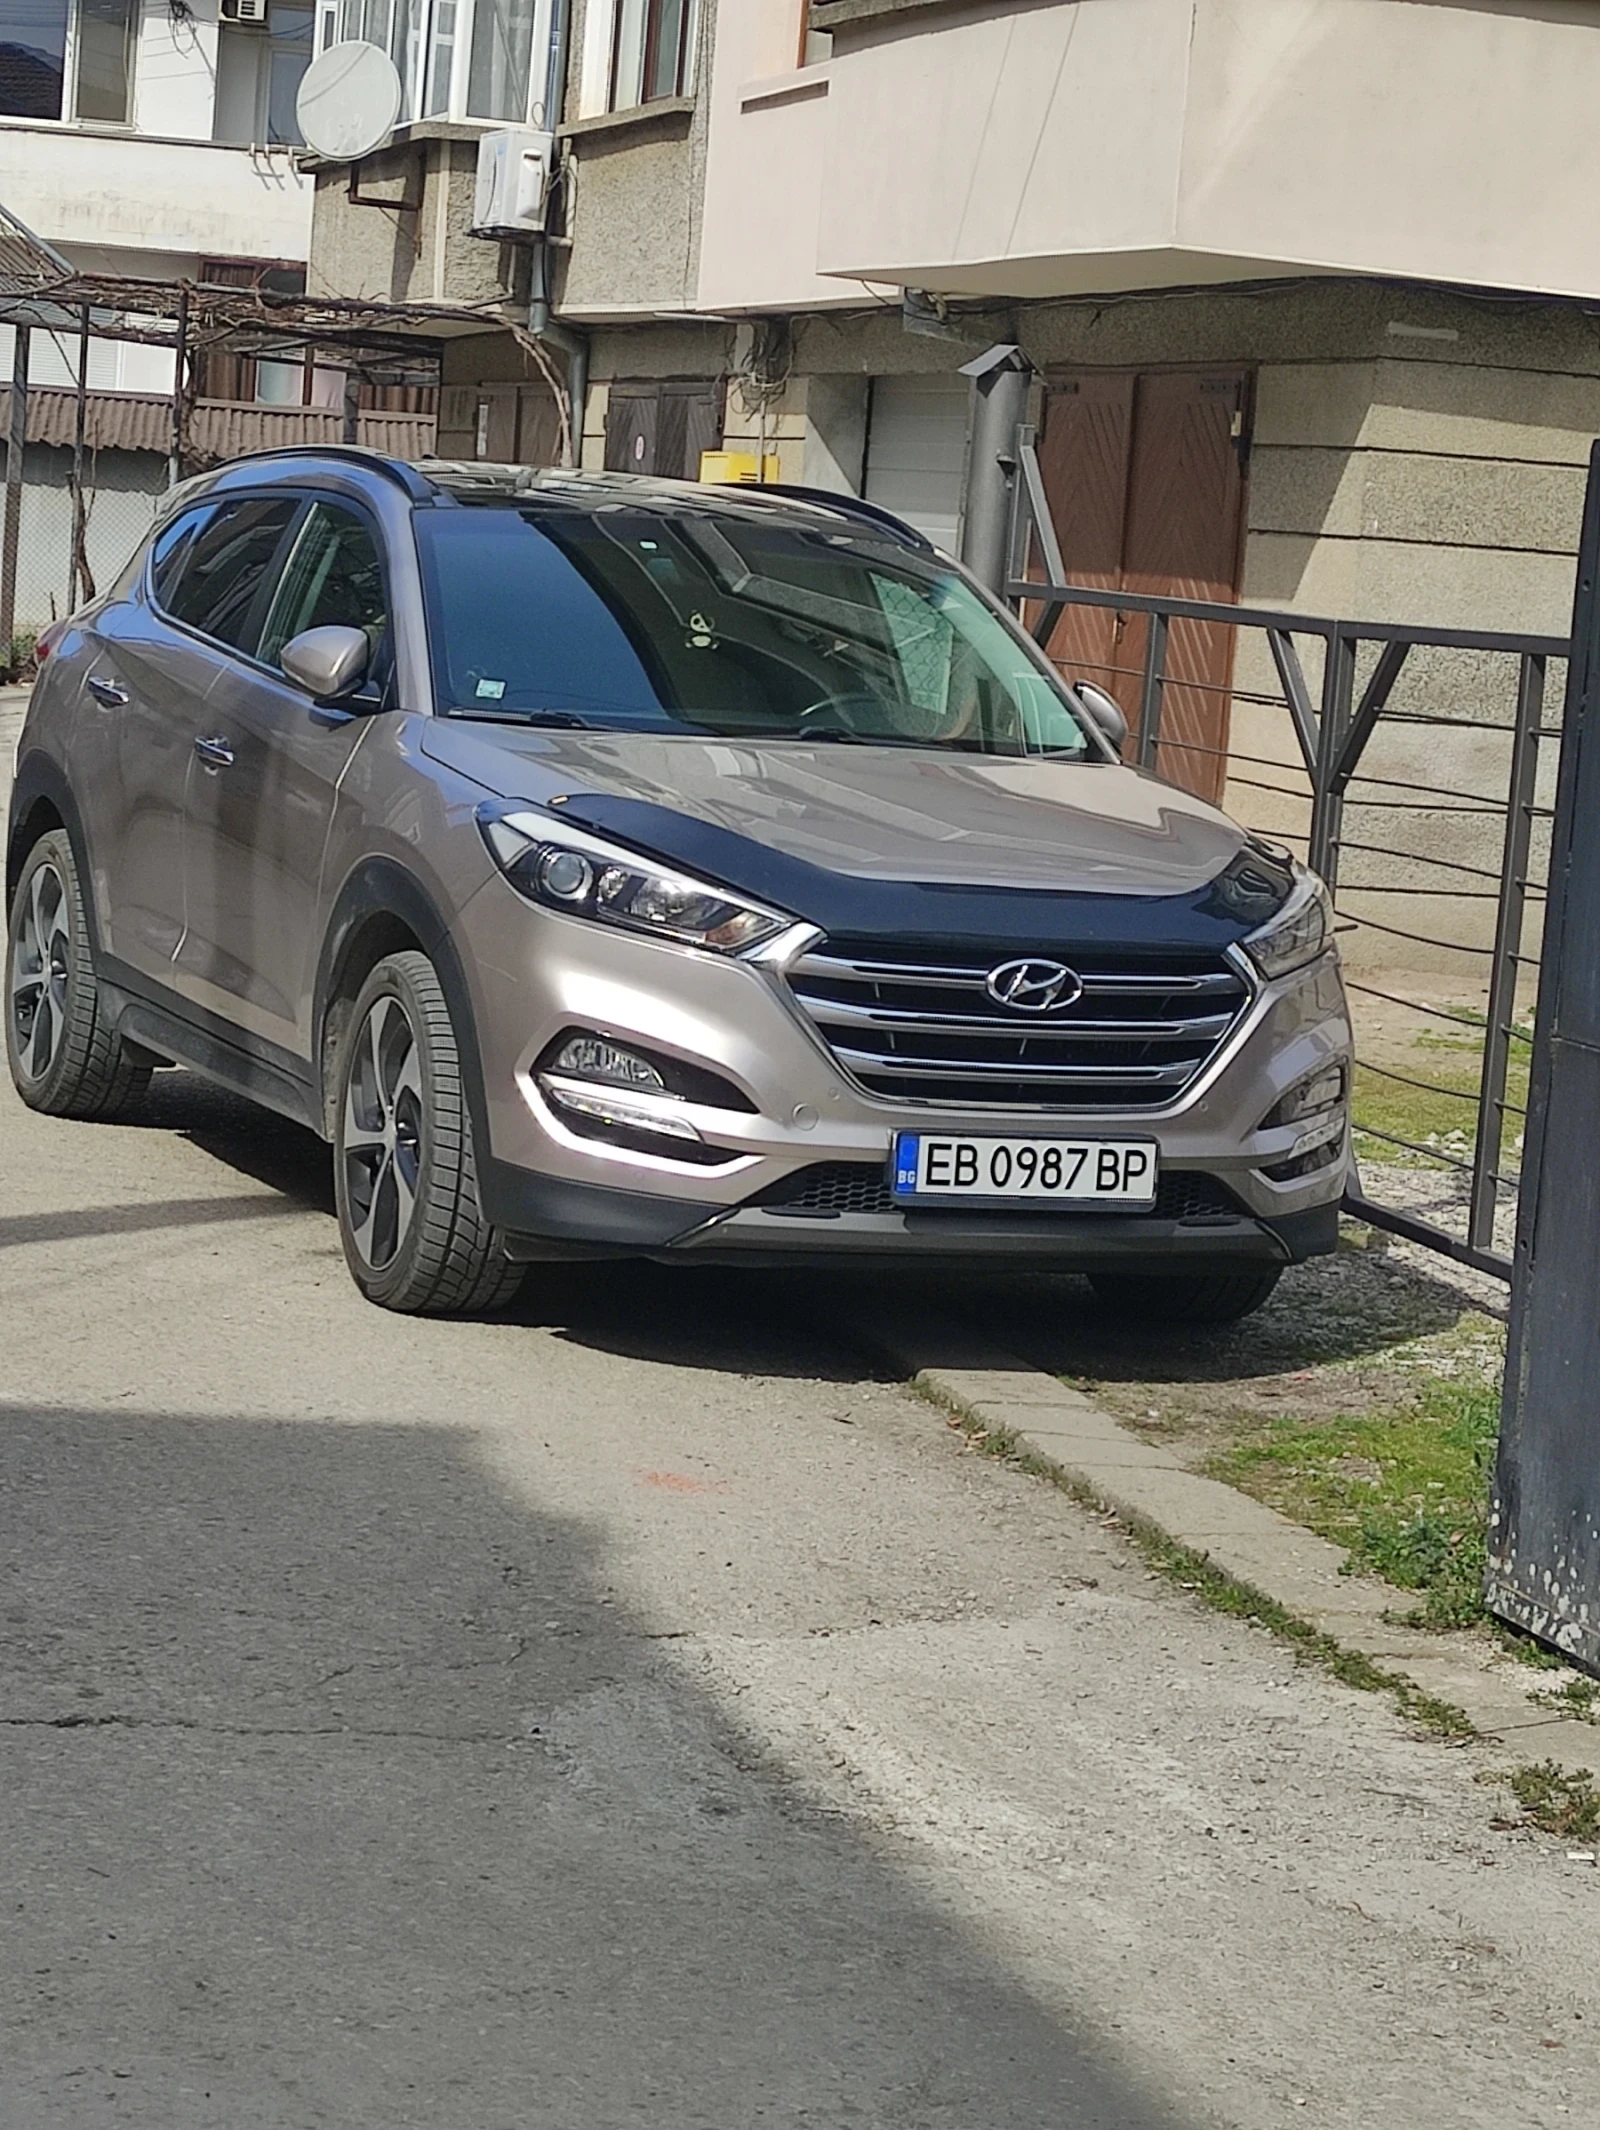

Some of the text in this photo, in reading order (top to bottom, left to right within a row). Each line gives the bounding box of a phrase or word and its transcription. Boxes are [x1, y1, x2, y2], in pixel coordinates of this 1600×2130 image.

[898, 1170, 916, 1184] BG
[926, 1143, 1147, 1191] EB 0987 BP
